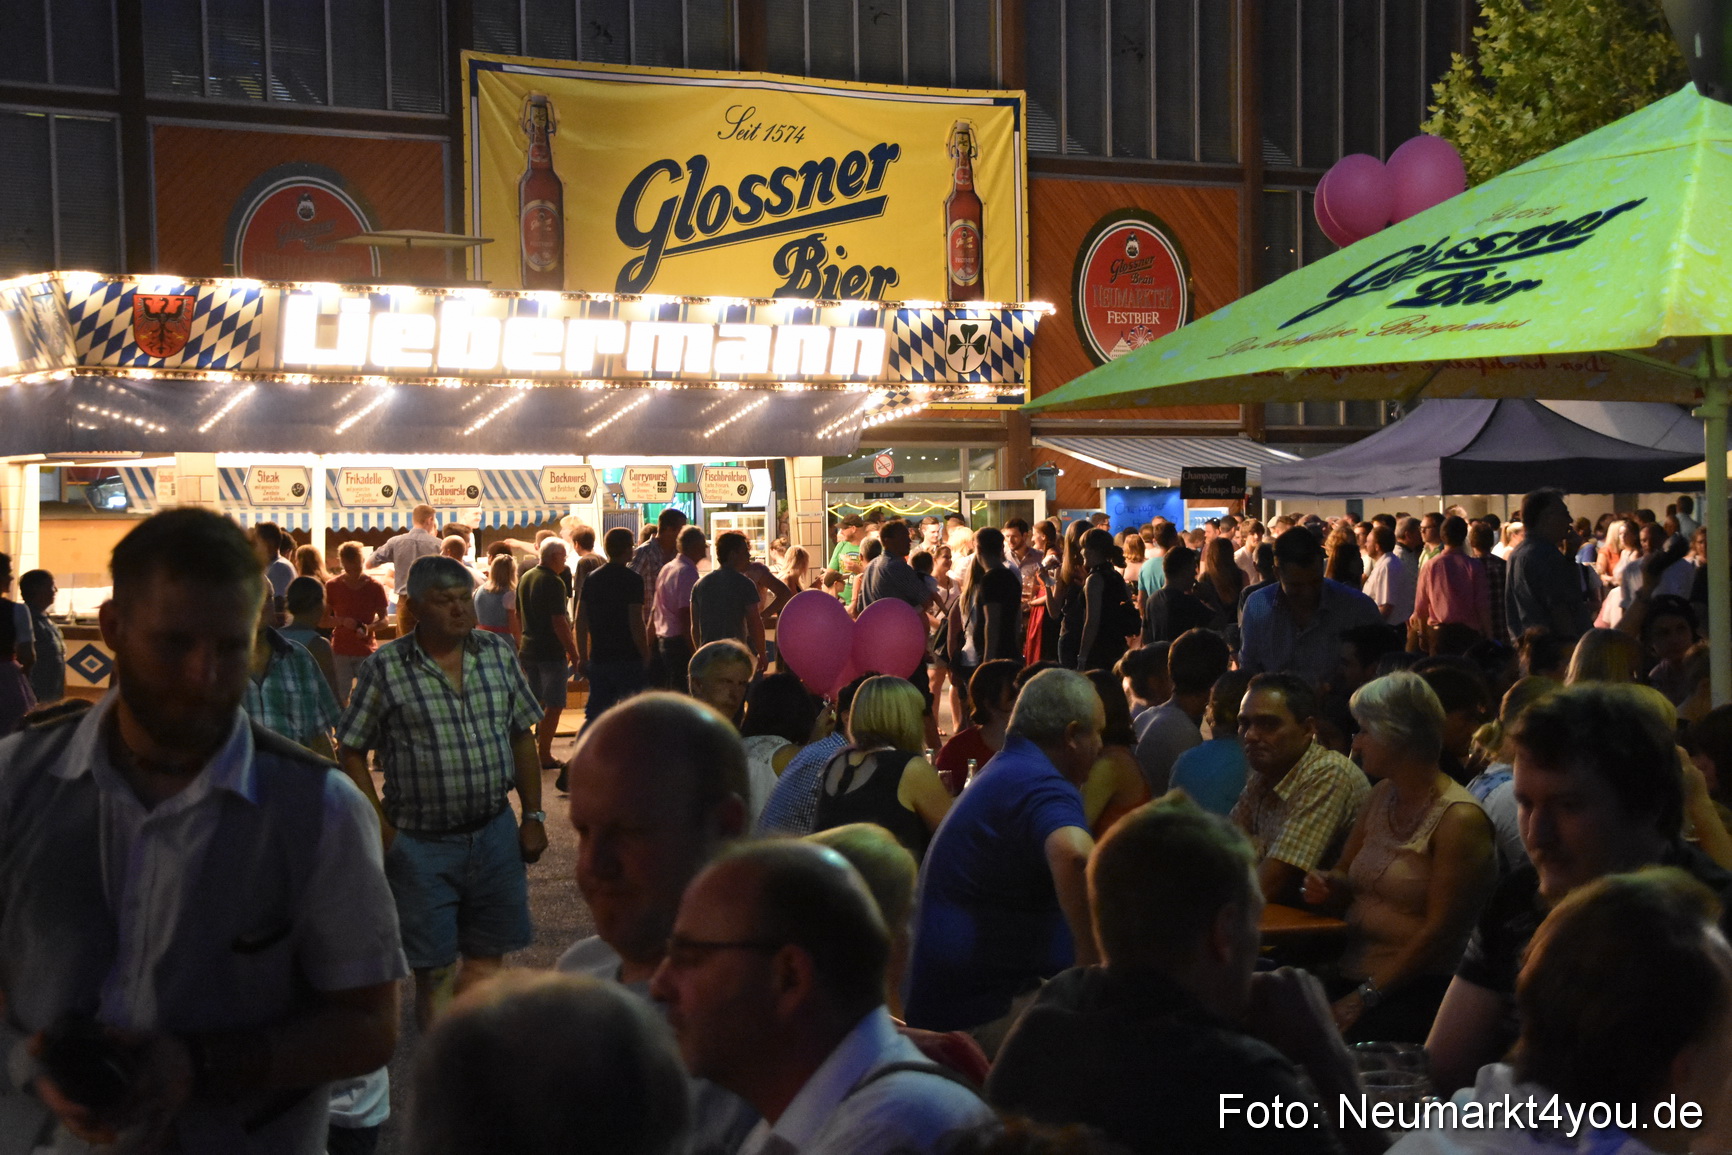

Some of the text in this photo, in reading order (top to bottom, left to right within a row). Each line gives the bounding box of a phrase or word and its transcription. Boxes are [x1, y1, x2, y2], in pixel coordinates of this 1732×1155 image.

[717, 104, 806, 144] Seit 1574
[615, 142, 901, 293] Glossner
[773, 232, 899, 299] Bier
[1110, 256, 1156, 284] Glossner
[1277, 197, 1647, 330] Glossner
[1386, 266, 1543, 309] Bier
[1092, 285, 1175, 310] NEUMARKTER
[1107, 310, 1161, 325] FESTBIER
[257, 469, 280, 483] Steak
[345, 472, 382, 485] Frikadelle
[438, 473, 456, 484] Paar
[549, 471, 587, 484] Bockwurst
[629, 468, 668, 483] Currywurst
[704, 469, 747, 483] Fischbrötchen
[1182, 471, 1229, 482] Champagner
[429, 484, 466, 497] Bratwürste
[1200, 486, 1229, 496] Schnaps
[1231, 486, 1244, 494] Bar
